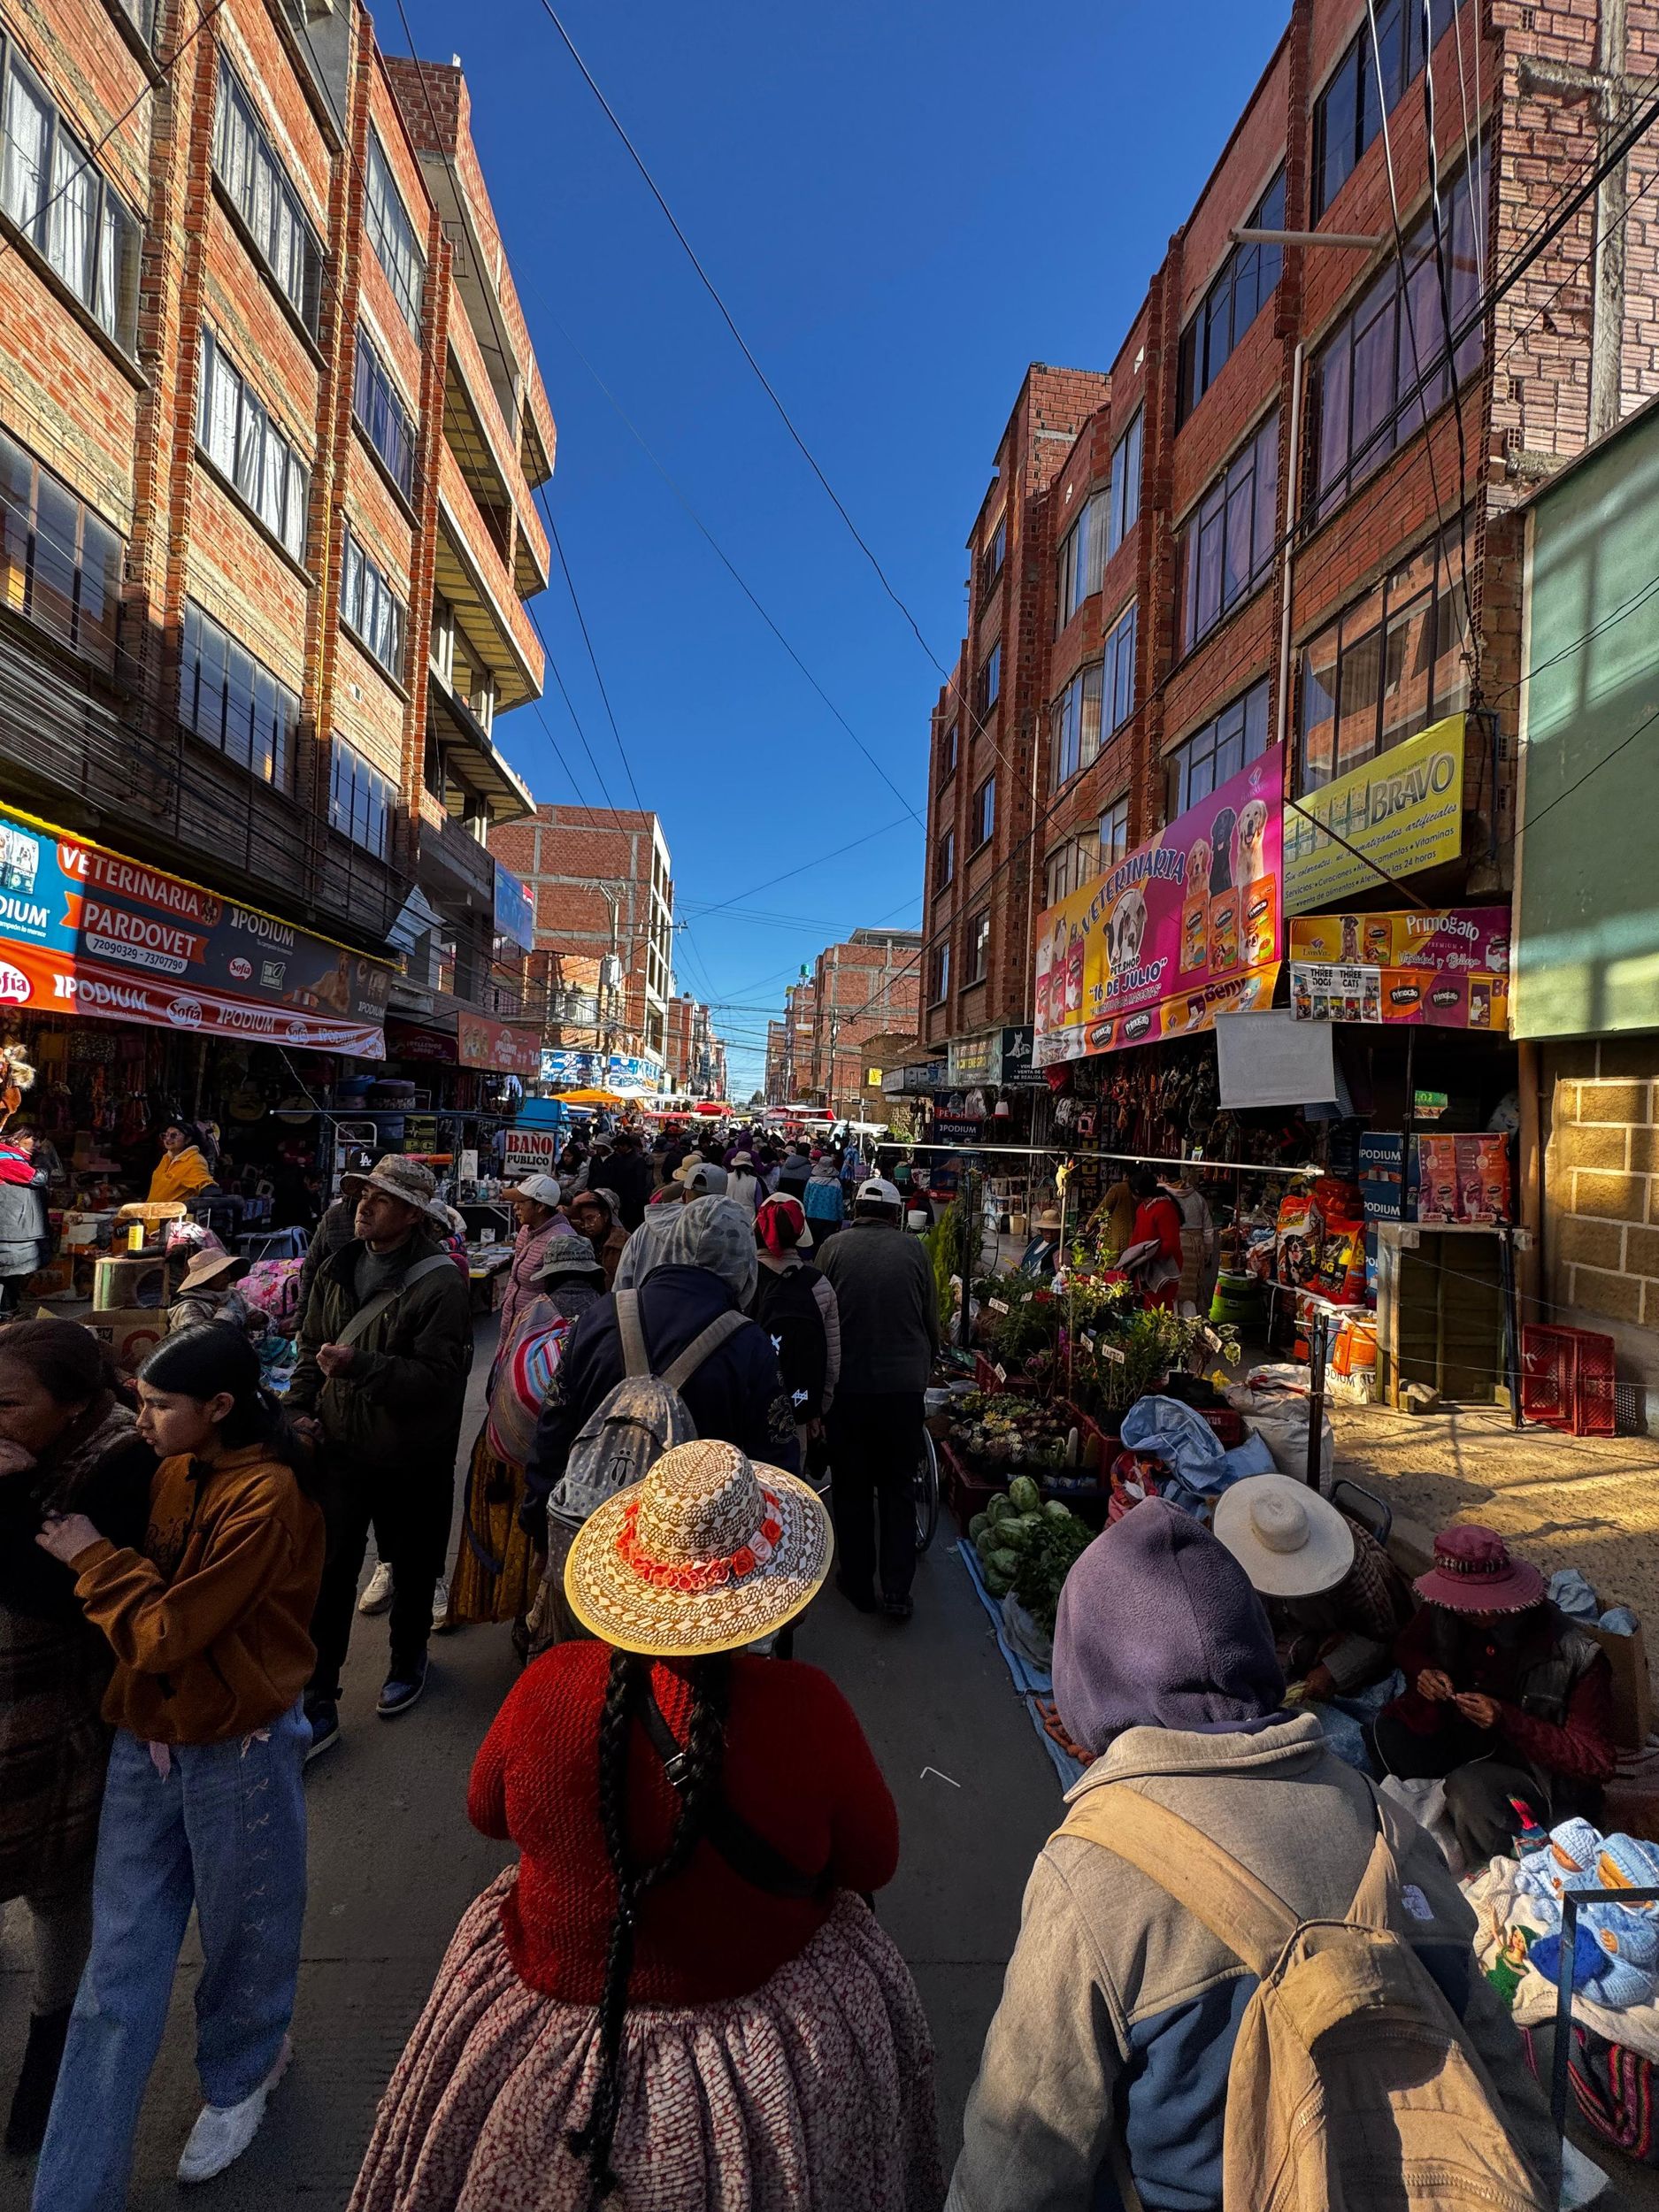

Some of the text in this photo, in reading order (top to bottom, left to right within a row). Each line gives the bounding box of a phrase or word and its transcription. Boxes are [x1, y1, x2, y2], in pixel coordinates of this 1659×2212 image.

[1370, 751, 1455, 826] BRAVO
[1416, 826, 1455, 848] Vitaminas
[62, 844, 199, 917] VETERINARIA
[1317, 892, 1325, 901] de
[1393, 863, 1402, 872] las
[1404, 857, 1413, 868] 24
[1415, 849, 1437, 864] horas
[1081, 848, 1186, 934] VETERINARIA
[83, 903, 197, 957] PARDOVET
[239, 911, 296, 947] PODIUM
[1405, 915, 1479, 941] Primogato
[94, 938, 183, 970] 72090329 73707790
[0, 972, 27, 994] fía
[1310, 969, 1333, 978] THREE
[1312, 977, 1332, 987] DOGS
[65, 976, 149, 1011] PODIUM
[1106, 979, 1119, 997] DE
[1204, 978, 1247, 1002] Beny
[169, 1002, 201, 1023] Sofía
[223, 1007, 275, 1033] PODIUM
[362, 1002, 385, 1018] PODIUM
[943, 1124, 977, 1133] PODIUM
[508, 1133, 553, 1154] BAÑO
[1361, 1148, 1402, 1161] PODIUM
[359, 1152, 372, 1167] LA
[507, 1155, 549, 1166] PUBLICO
[1363, 1201, 1401, 1216] PODIUM
